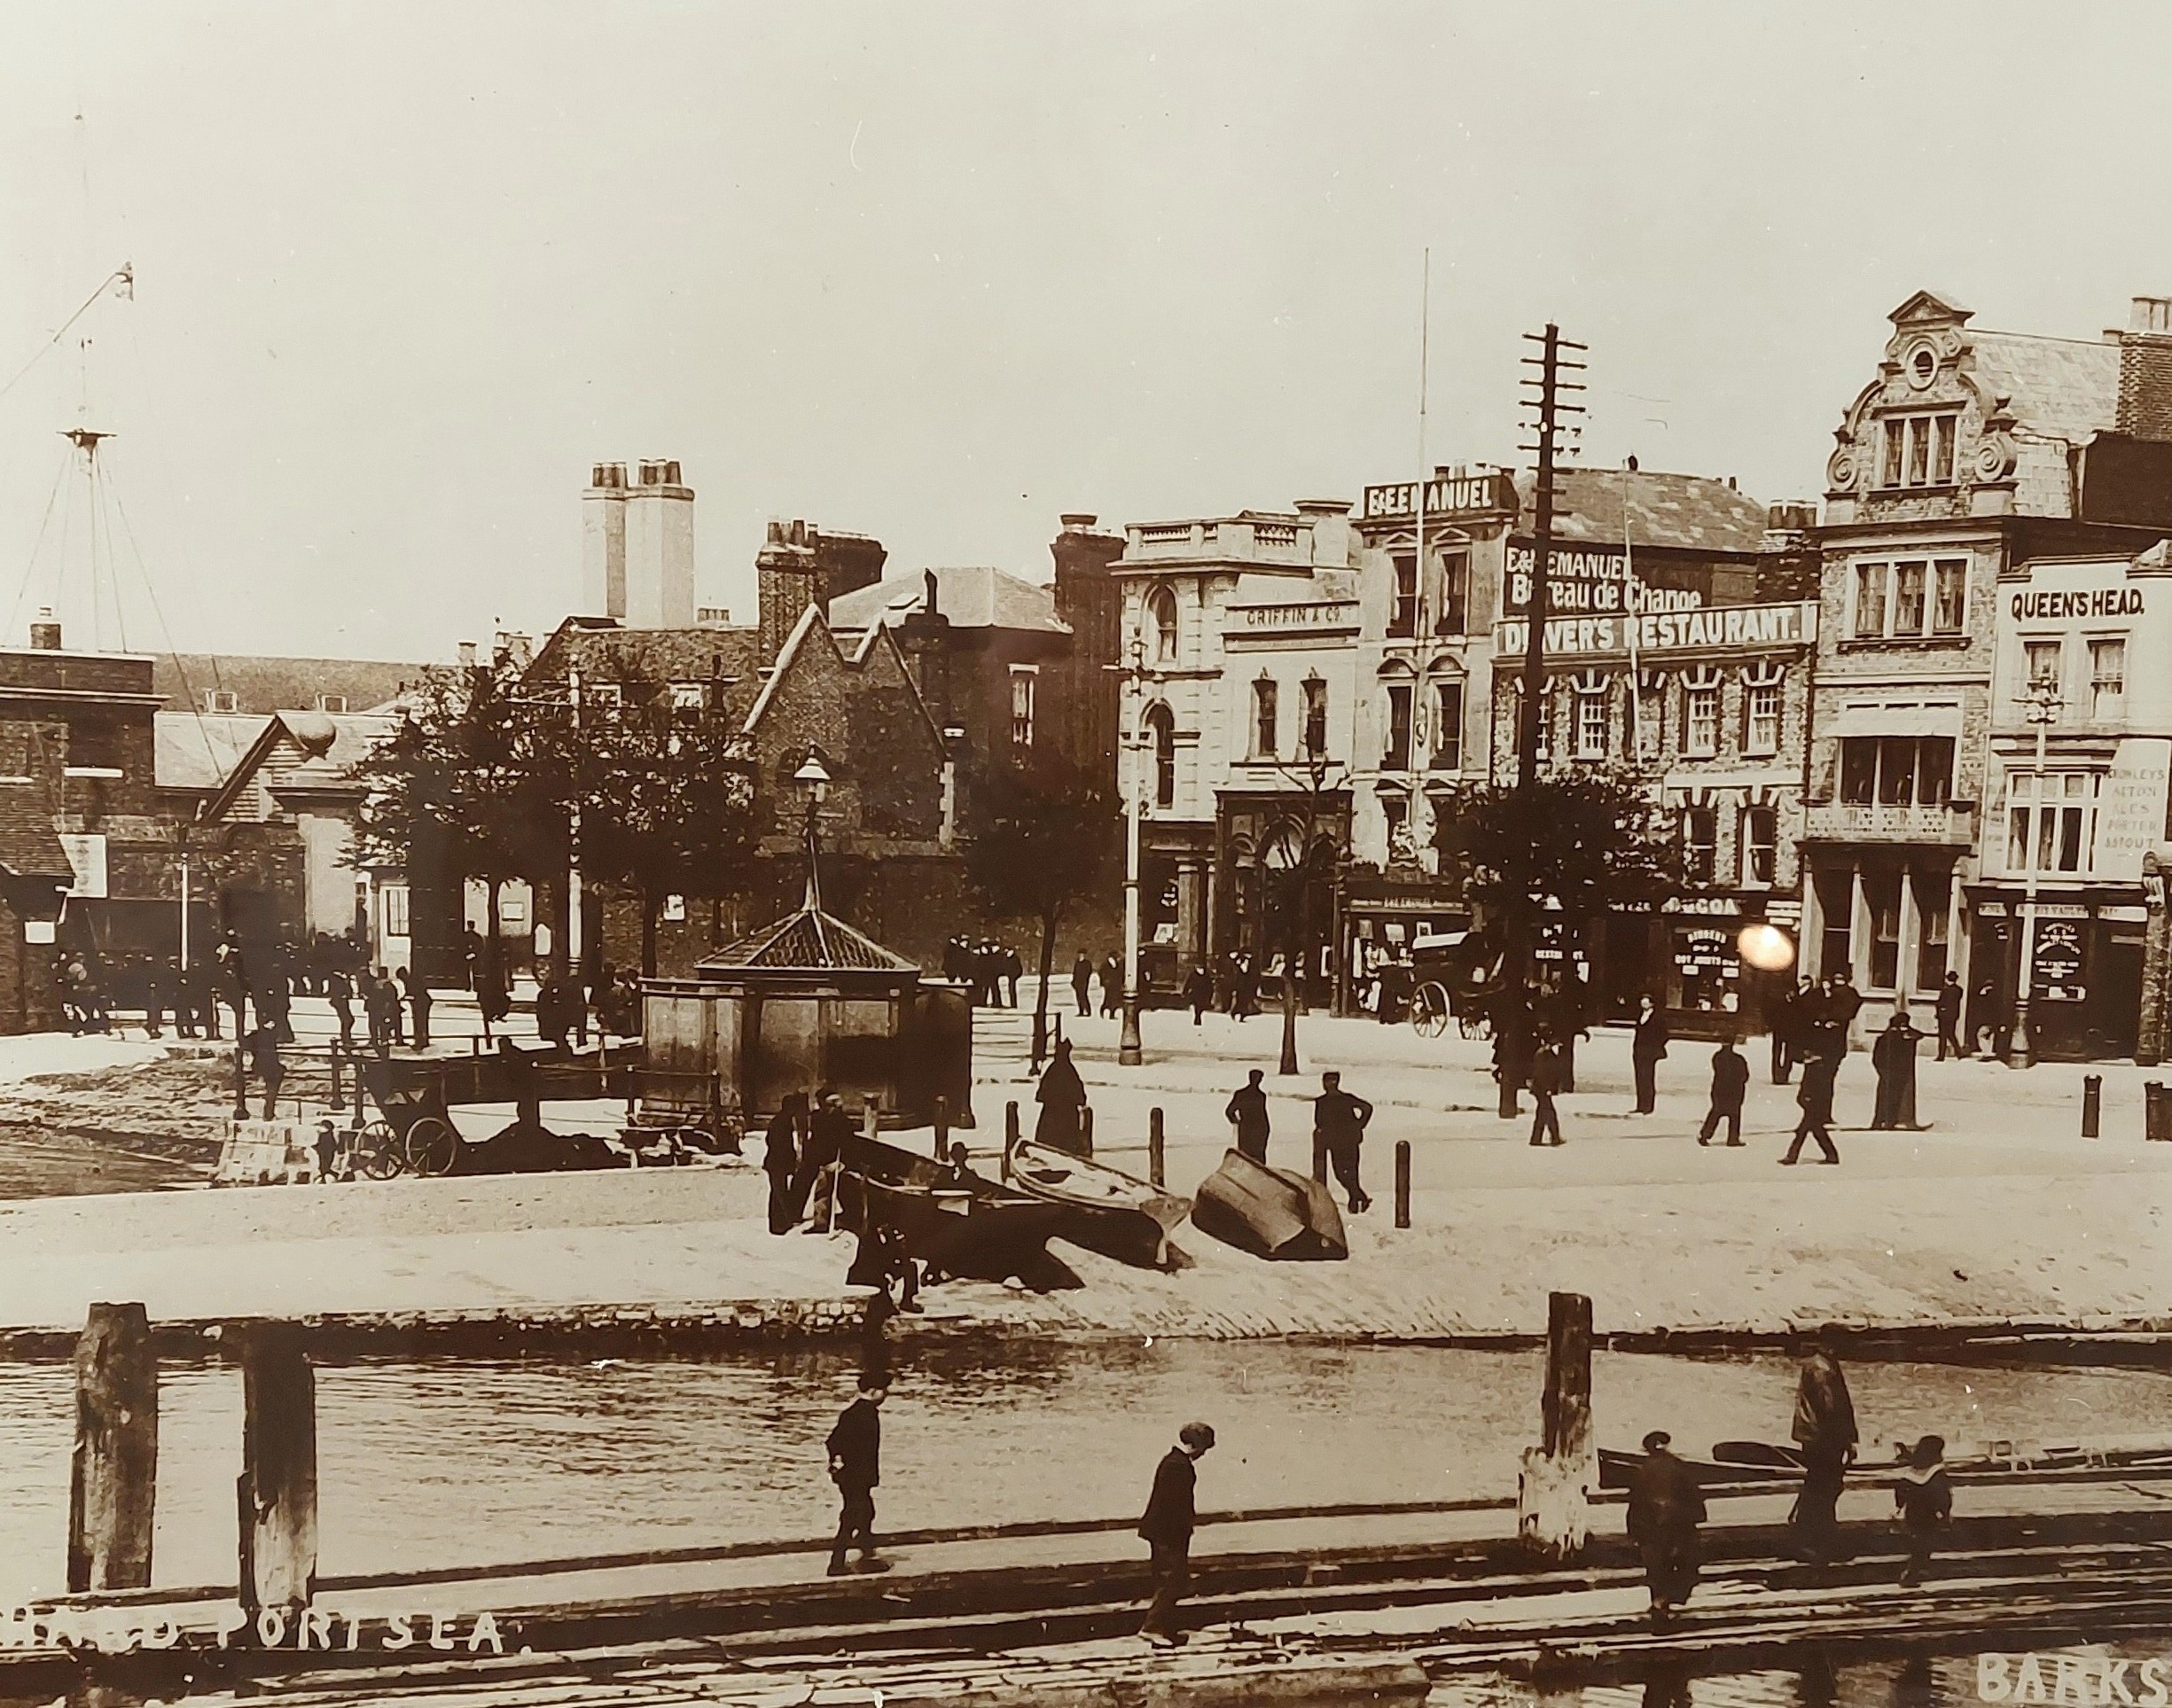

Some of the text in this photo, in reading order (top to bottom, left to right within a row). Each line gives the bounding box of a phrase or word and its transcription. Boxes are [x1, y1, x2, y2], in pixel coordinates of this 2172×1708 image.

[1512, 573, 1590, 610] Beau
[1593, 580, 1619, 610] de
[1246, 608, 1307, 626] GRIFFIN
[1623, 607, 1799, 649] RESTAURANT.
